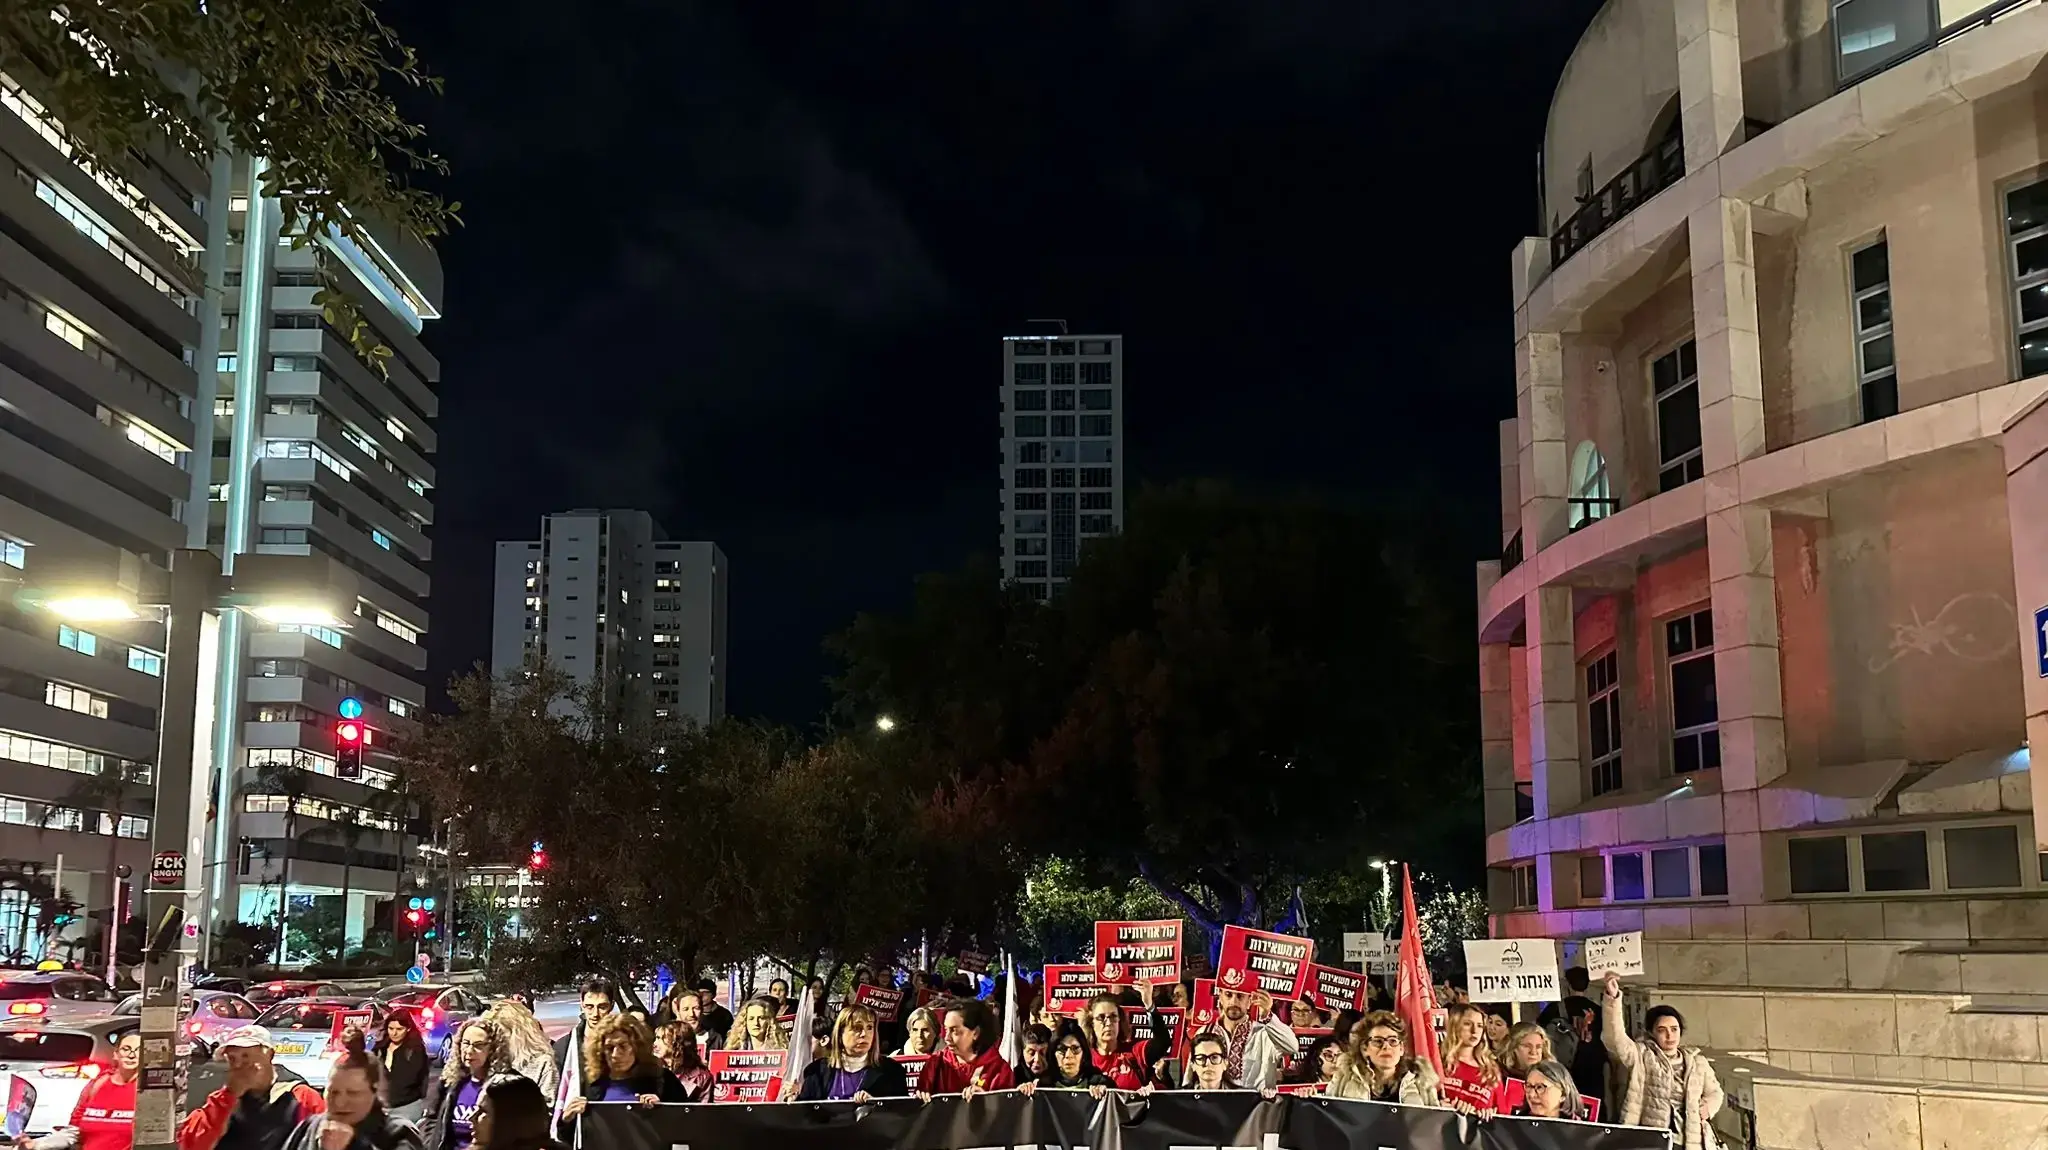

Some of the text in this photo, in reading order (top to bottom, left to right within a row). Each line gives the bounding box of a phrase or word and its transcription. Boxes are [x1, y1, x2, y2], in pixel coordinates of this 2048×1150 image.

[154, 857, 184, 869] FCK
[153, 869, 184, 877] BNGVR
[1119, 925, 1175, 939] קול אחיותינו
[1592, 935, 1630, 946] war is
[1109, 945, 1174, 960] זועק אלינו
[1249, 938, 1306, 959] לא משאירות
[1135, 965, 1175, 979] מן האדמה
[1251, 956, 1298, 975] אף אחת
[1257, 976, 1293, 993] מאחור
[1350, 978, 1361, 989] לא
[1473, 974, 1553, 994] אנחנו איתך
[1054, 987, 1081, 998] להיות
[1320, 984, 1355, 999] אף אחת
[1169, 1014, 1179, 1025] לא
[767, 1053, 781, 1065] קול
[720, 1069, 750, 1082] אלינו
